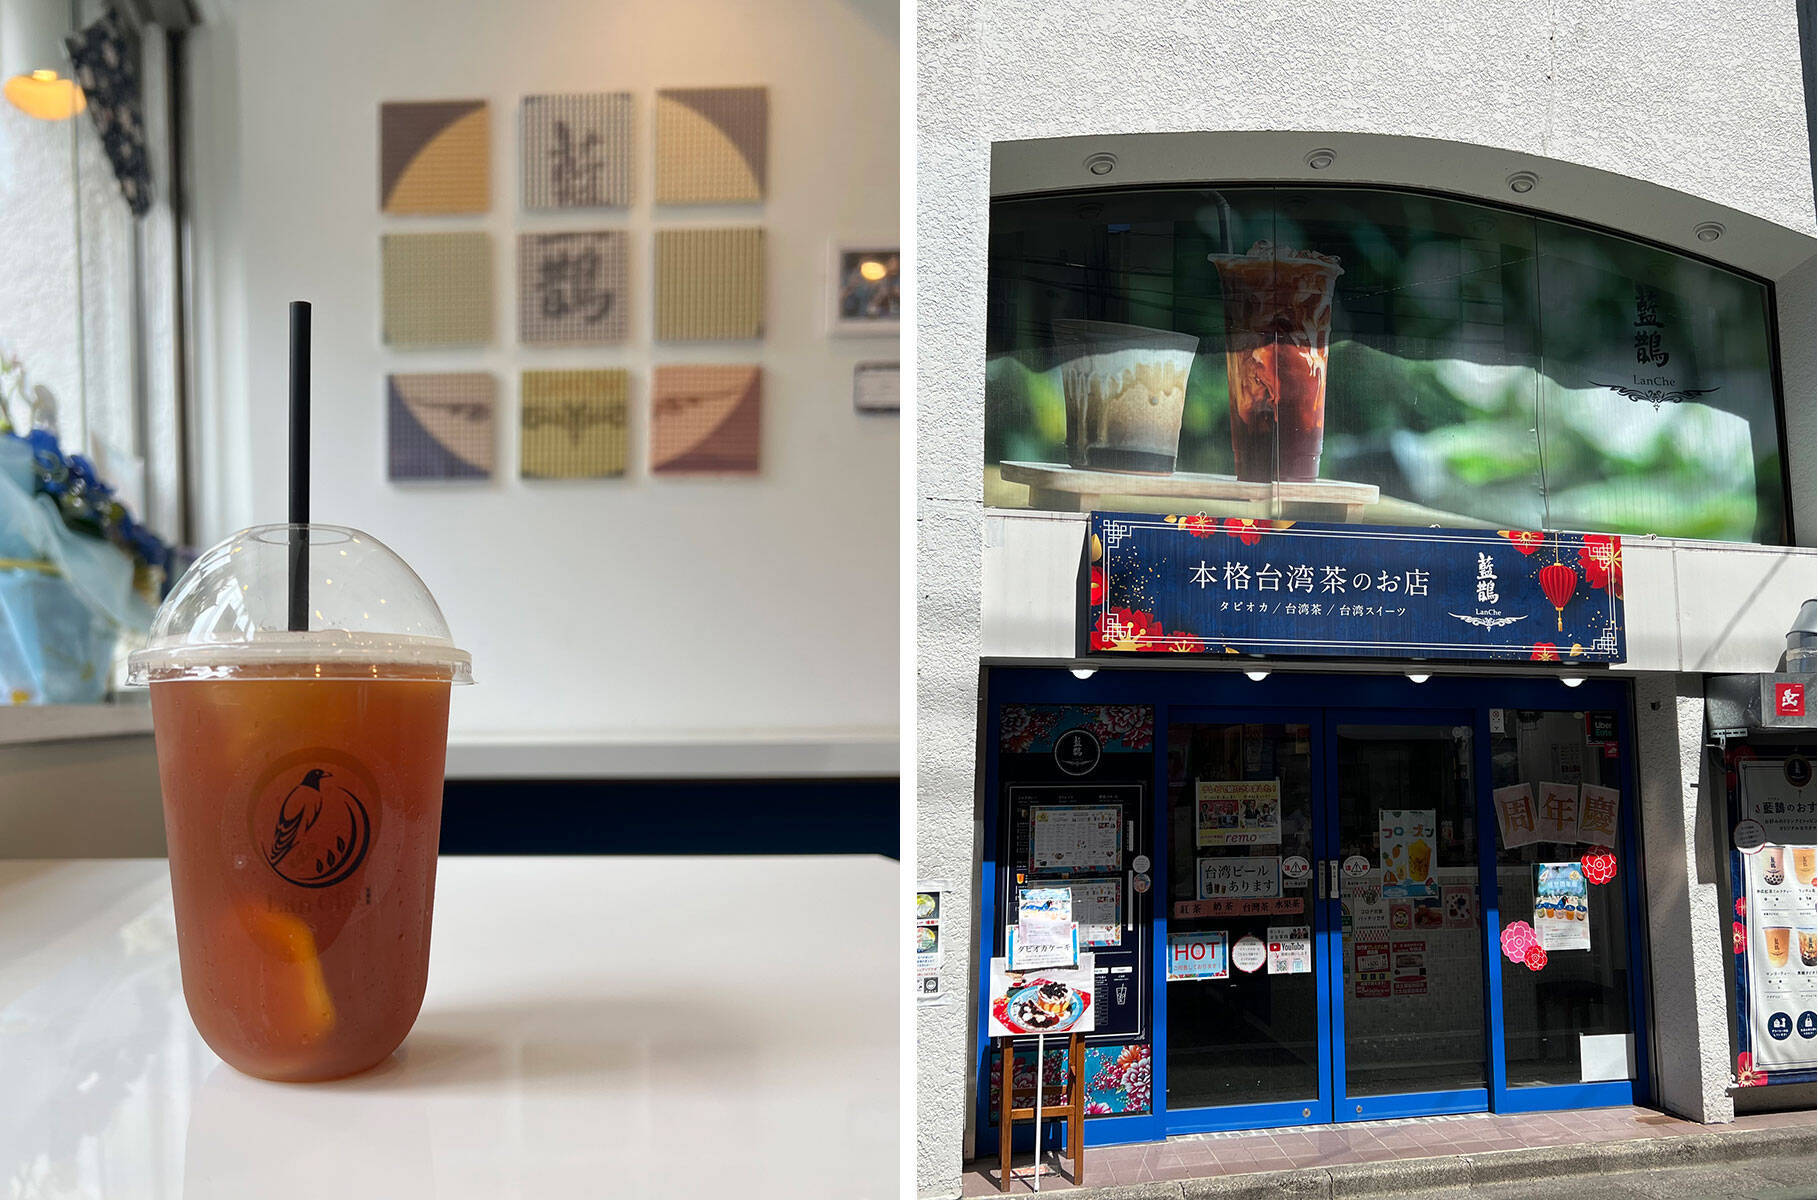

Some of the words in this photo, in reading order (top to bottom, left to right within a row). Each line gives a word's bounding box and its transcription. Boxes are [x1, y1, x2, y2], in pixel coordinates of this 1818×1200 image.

[1633, 285, 1669, 367] 藍鵲
[1633, 375, 1676, 387] LanChe
[1188, 560, 1430, 597] 本格台湾茶のお店
[1476, 551, 1499, 604] 藍鵲
[1475, 608, 1502, 616] LanChe
[1594, 721, 1613, 729] Uber
[1594, 729, 1612, 737] Eats
[1500, 792, 1616, 838] 周年慶
[1382, 823, 1434, 839] フロズン
[1225, 834, 1257, 843] remo
[1205, 864, 1268, 879] 台湾ビール
[1229, 879, 1274, 893] あります
[1180, 904, 1201, 914] 紅茶
[1175, 942, 1220, 961] HOT
[1281, 942, 1305, 952] YouTube
